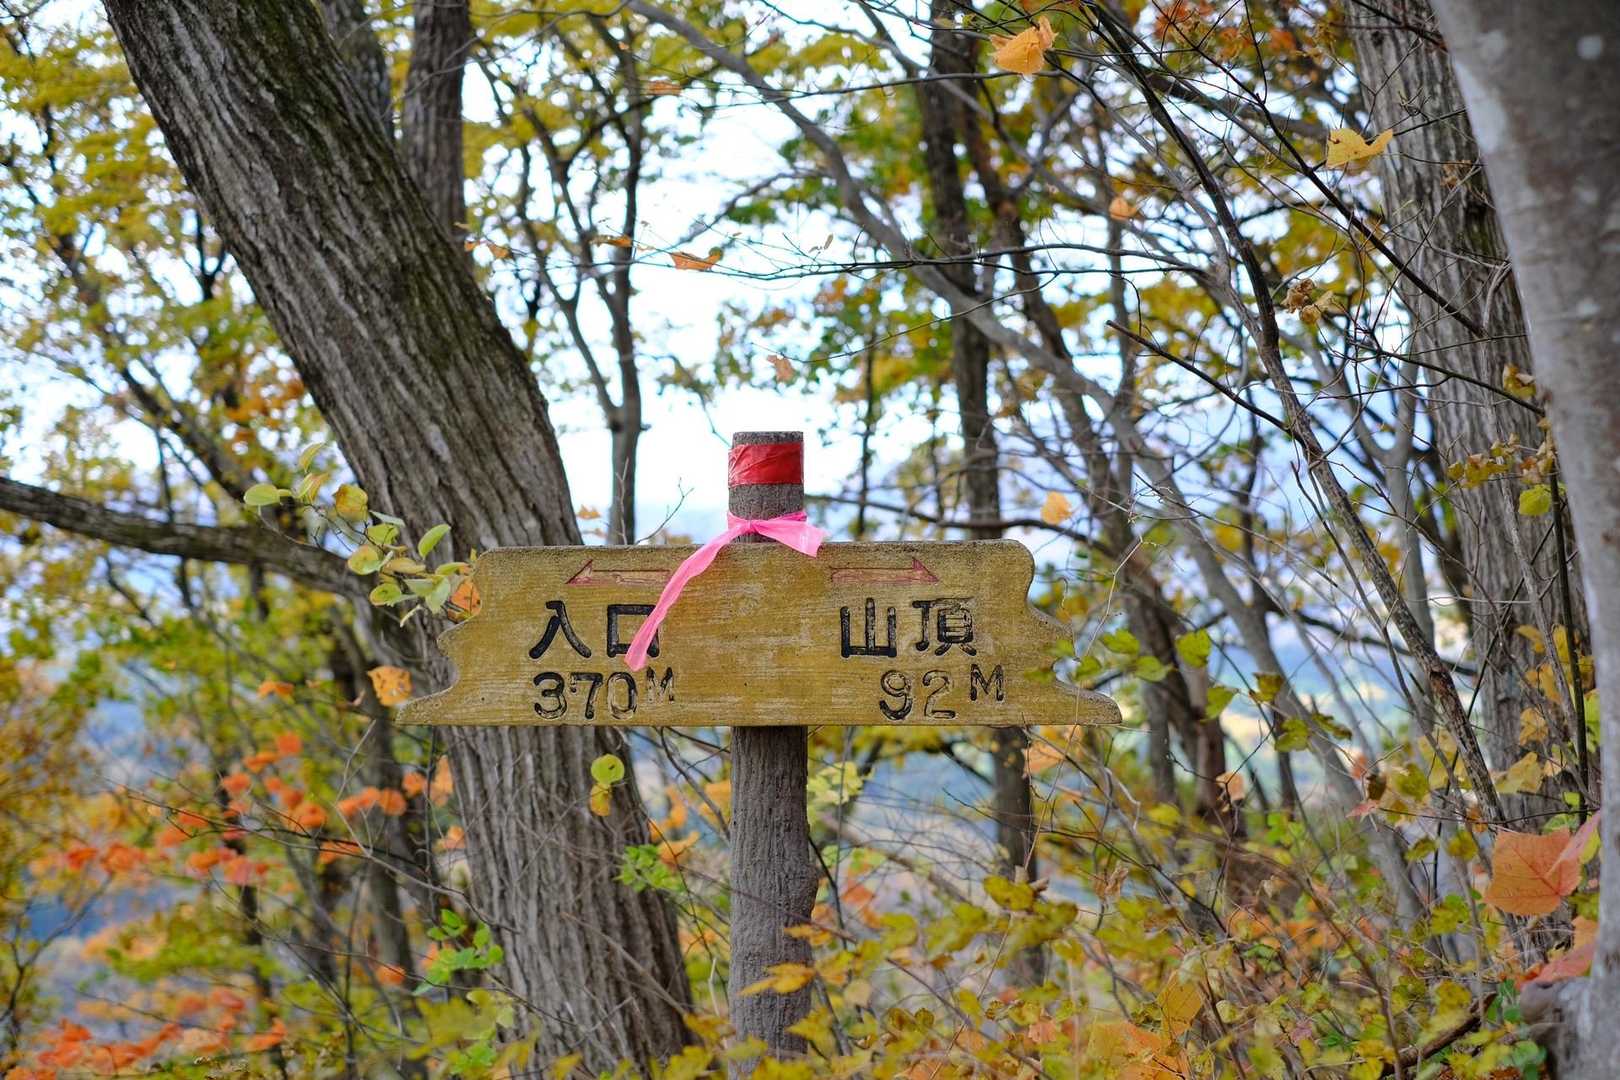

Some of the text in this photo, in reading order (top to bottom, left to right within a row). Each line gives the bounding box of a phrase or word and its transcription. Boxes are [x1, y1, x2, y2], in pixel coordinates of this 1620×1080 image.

[529, 600, 660, 659] 入口
[840, 597, 977, 658] 山頂
[533, 666, 675, 720] 370M
[879, 663, 1004, 720] 92M
